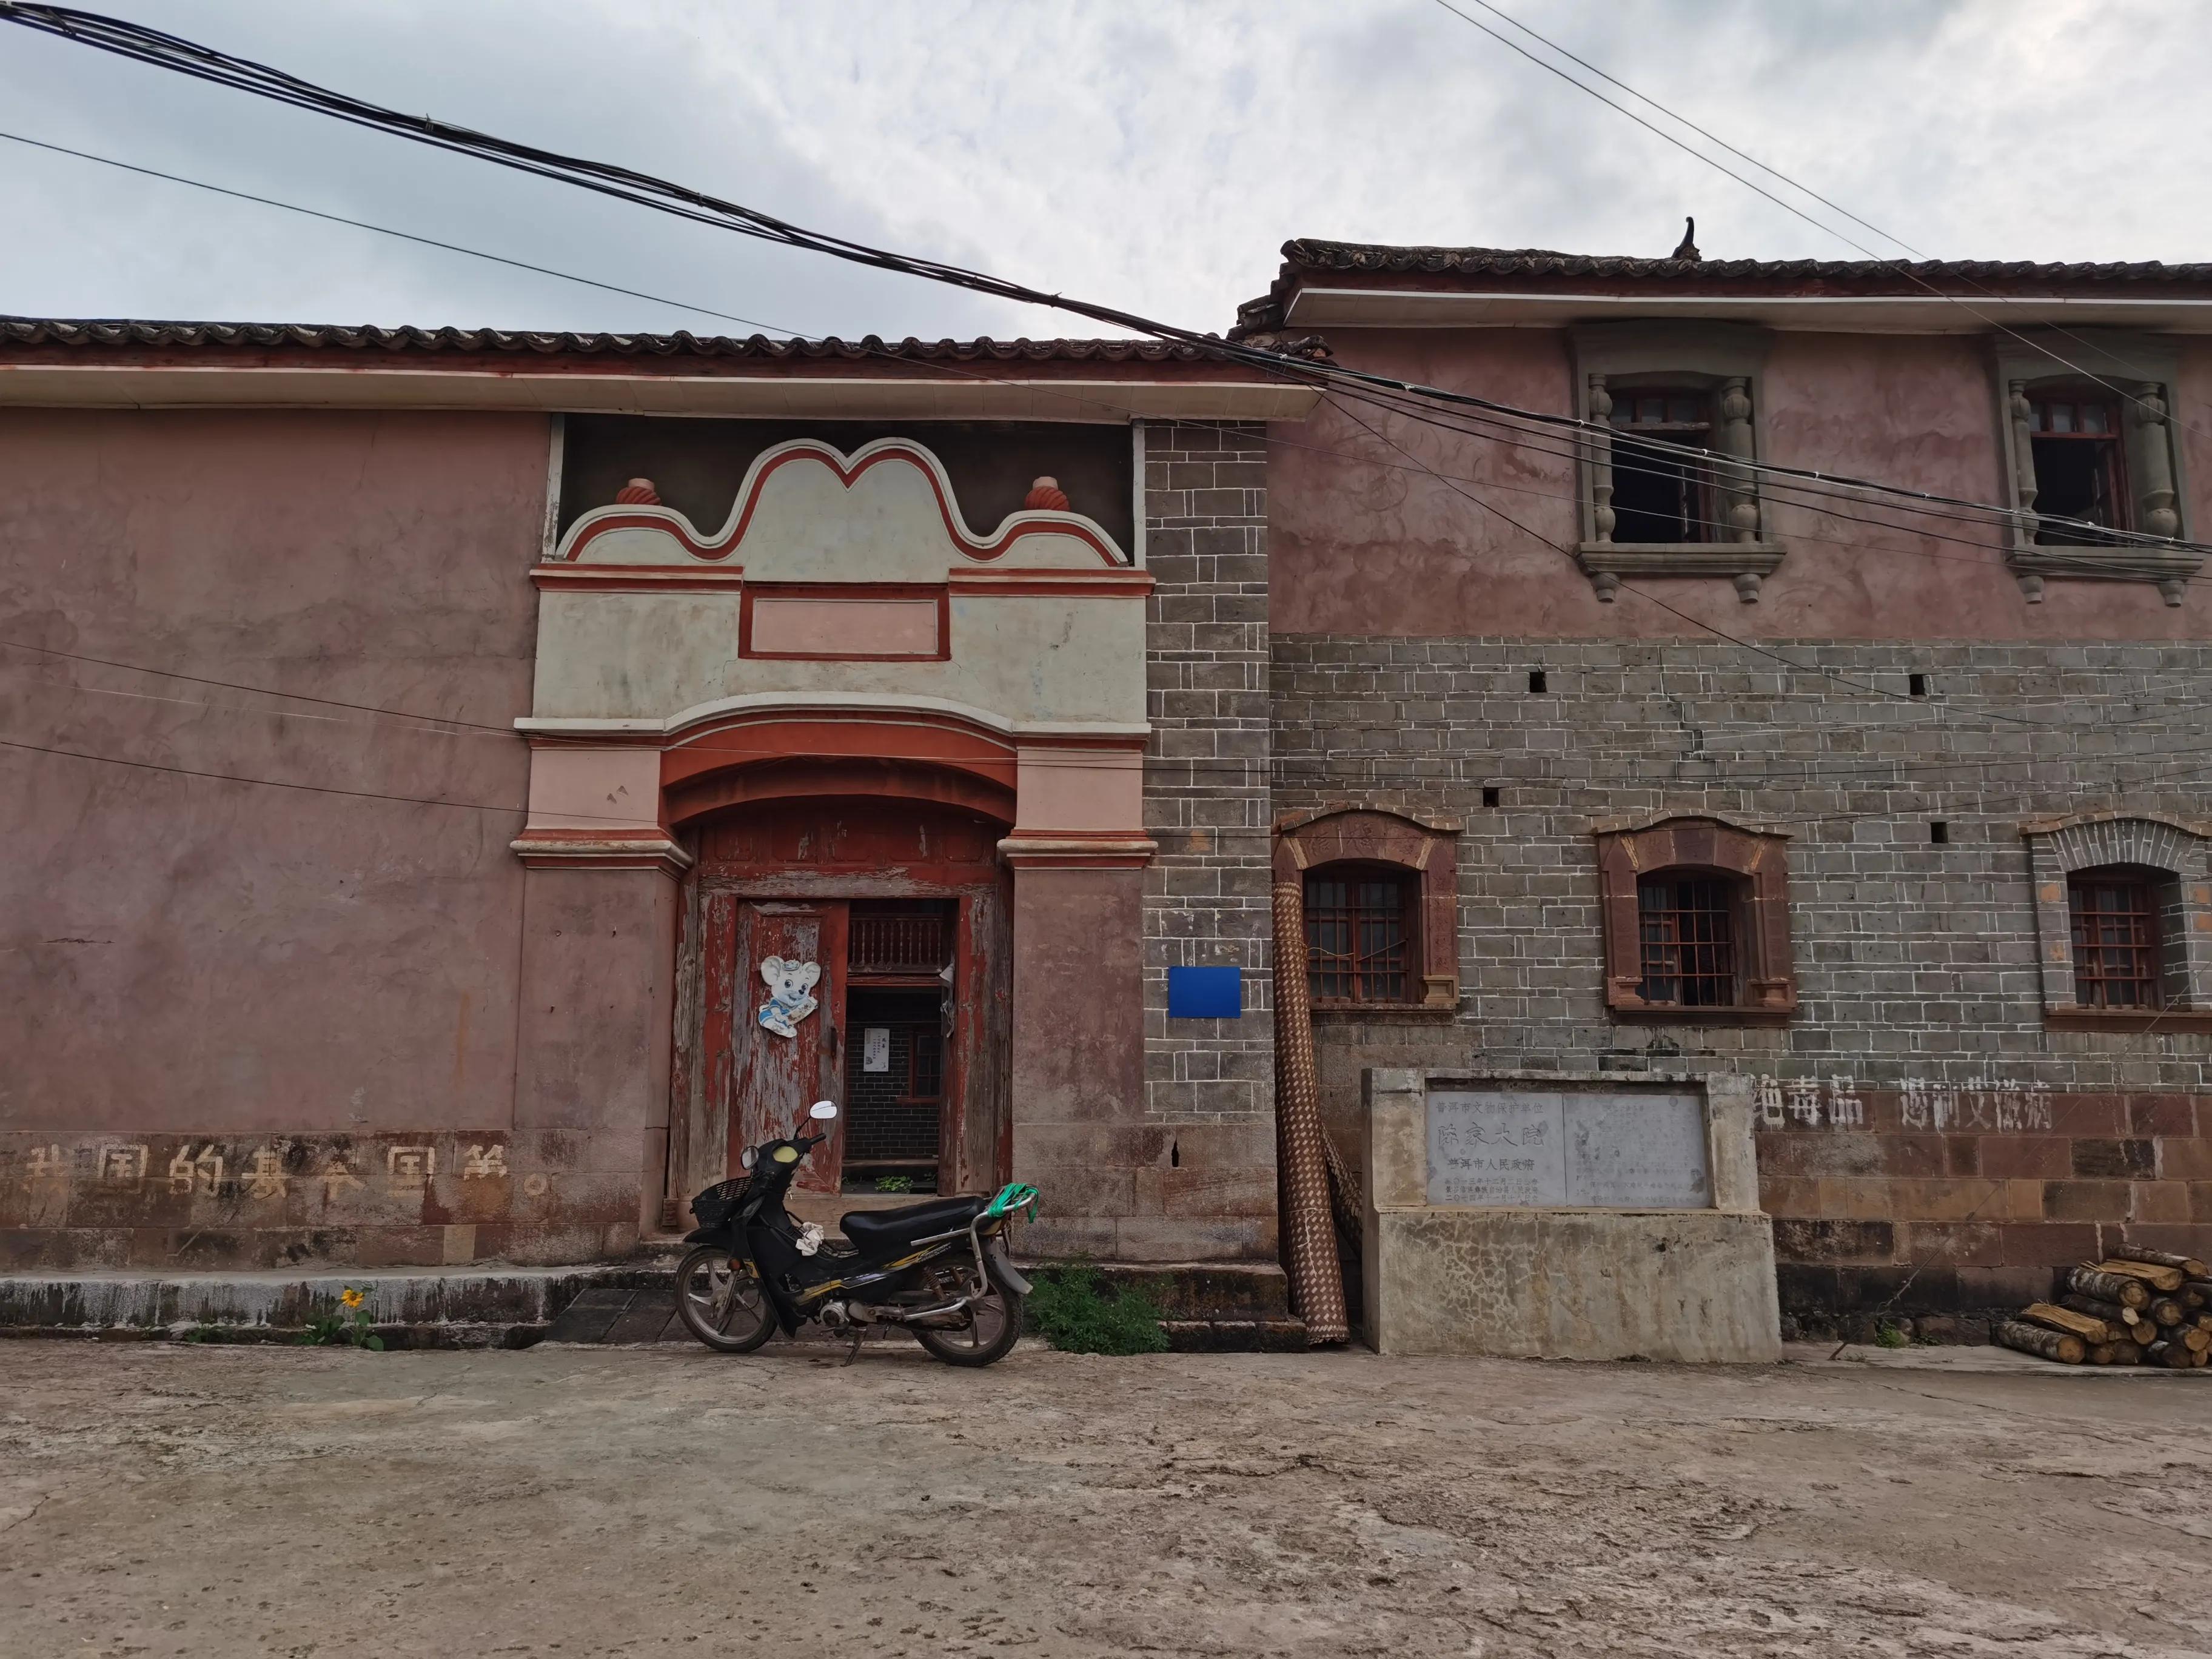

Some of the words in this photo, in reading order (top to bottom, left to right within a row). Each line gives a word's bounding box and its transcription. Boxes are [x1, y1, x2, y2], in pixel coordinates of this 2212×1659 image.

[1435, 1101, 1544, 1114] 普洱市文物保护单位
[1437, 1121, 1545, 1147] 陈家大院
[1447, 1158, 1536, 1171] 普洱市人民政府
